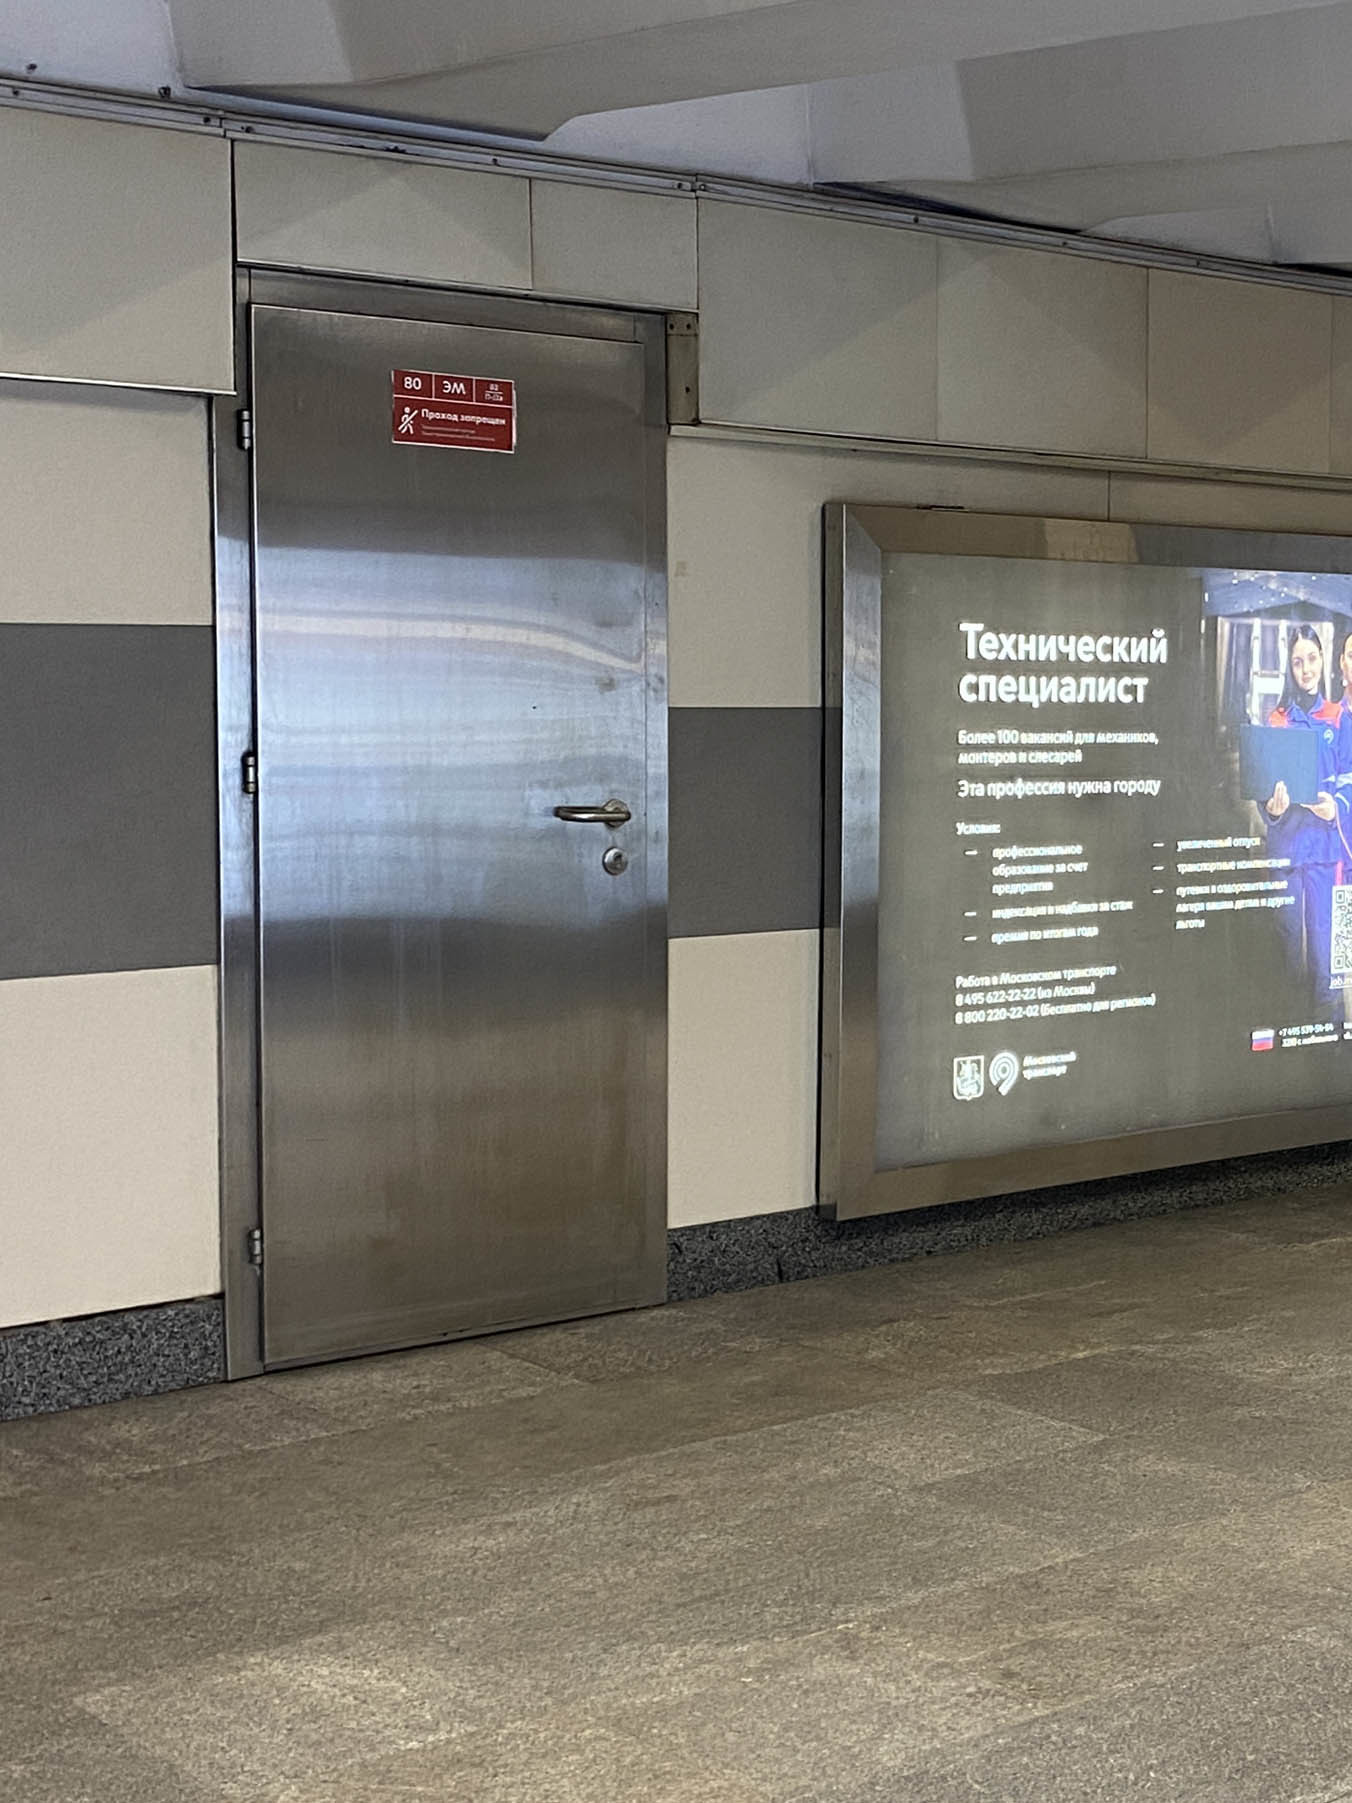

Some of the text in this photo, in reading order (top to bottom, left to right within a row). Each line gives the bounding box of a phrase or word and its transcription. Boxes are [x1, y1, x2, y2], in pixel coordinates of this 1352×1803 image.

[405, 377, 421, 389] 80
[443, 381, 466, 394] ЭМ
[422, 409, 505, 424] Проход запрещен
[960, 623, 1167, 663] Технический
[960, 673, 1149, 708] специалист
[959, 730, 1158, 745] Более 100 вакансий для механиков,
[958, 749, 1082, 766] монтеров и слесарей
[958, 778, 1161, 799] Эта профессия нужна городу
[993, 845, 1083, 860] профессиональное
[956, 975, 990, 988] Работа
[999, 971, 1062, 984] Московском
[1063, 966, 1116, 980] транспорте
[956, 994, 963, 1006] 8
[964, 992, 985, 1005] 495
[986, 988, 1037, 1004] 622-22-22
[1053, 982, 1095, 997] Москвы)
[956, 1012, 963, 1024] 8
[964, 1010, 986, 1023] 800
[987, 1005, 1039, 1021] 220-22-02
